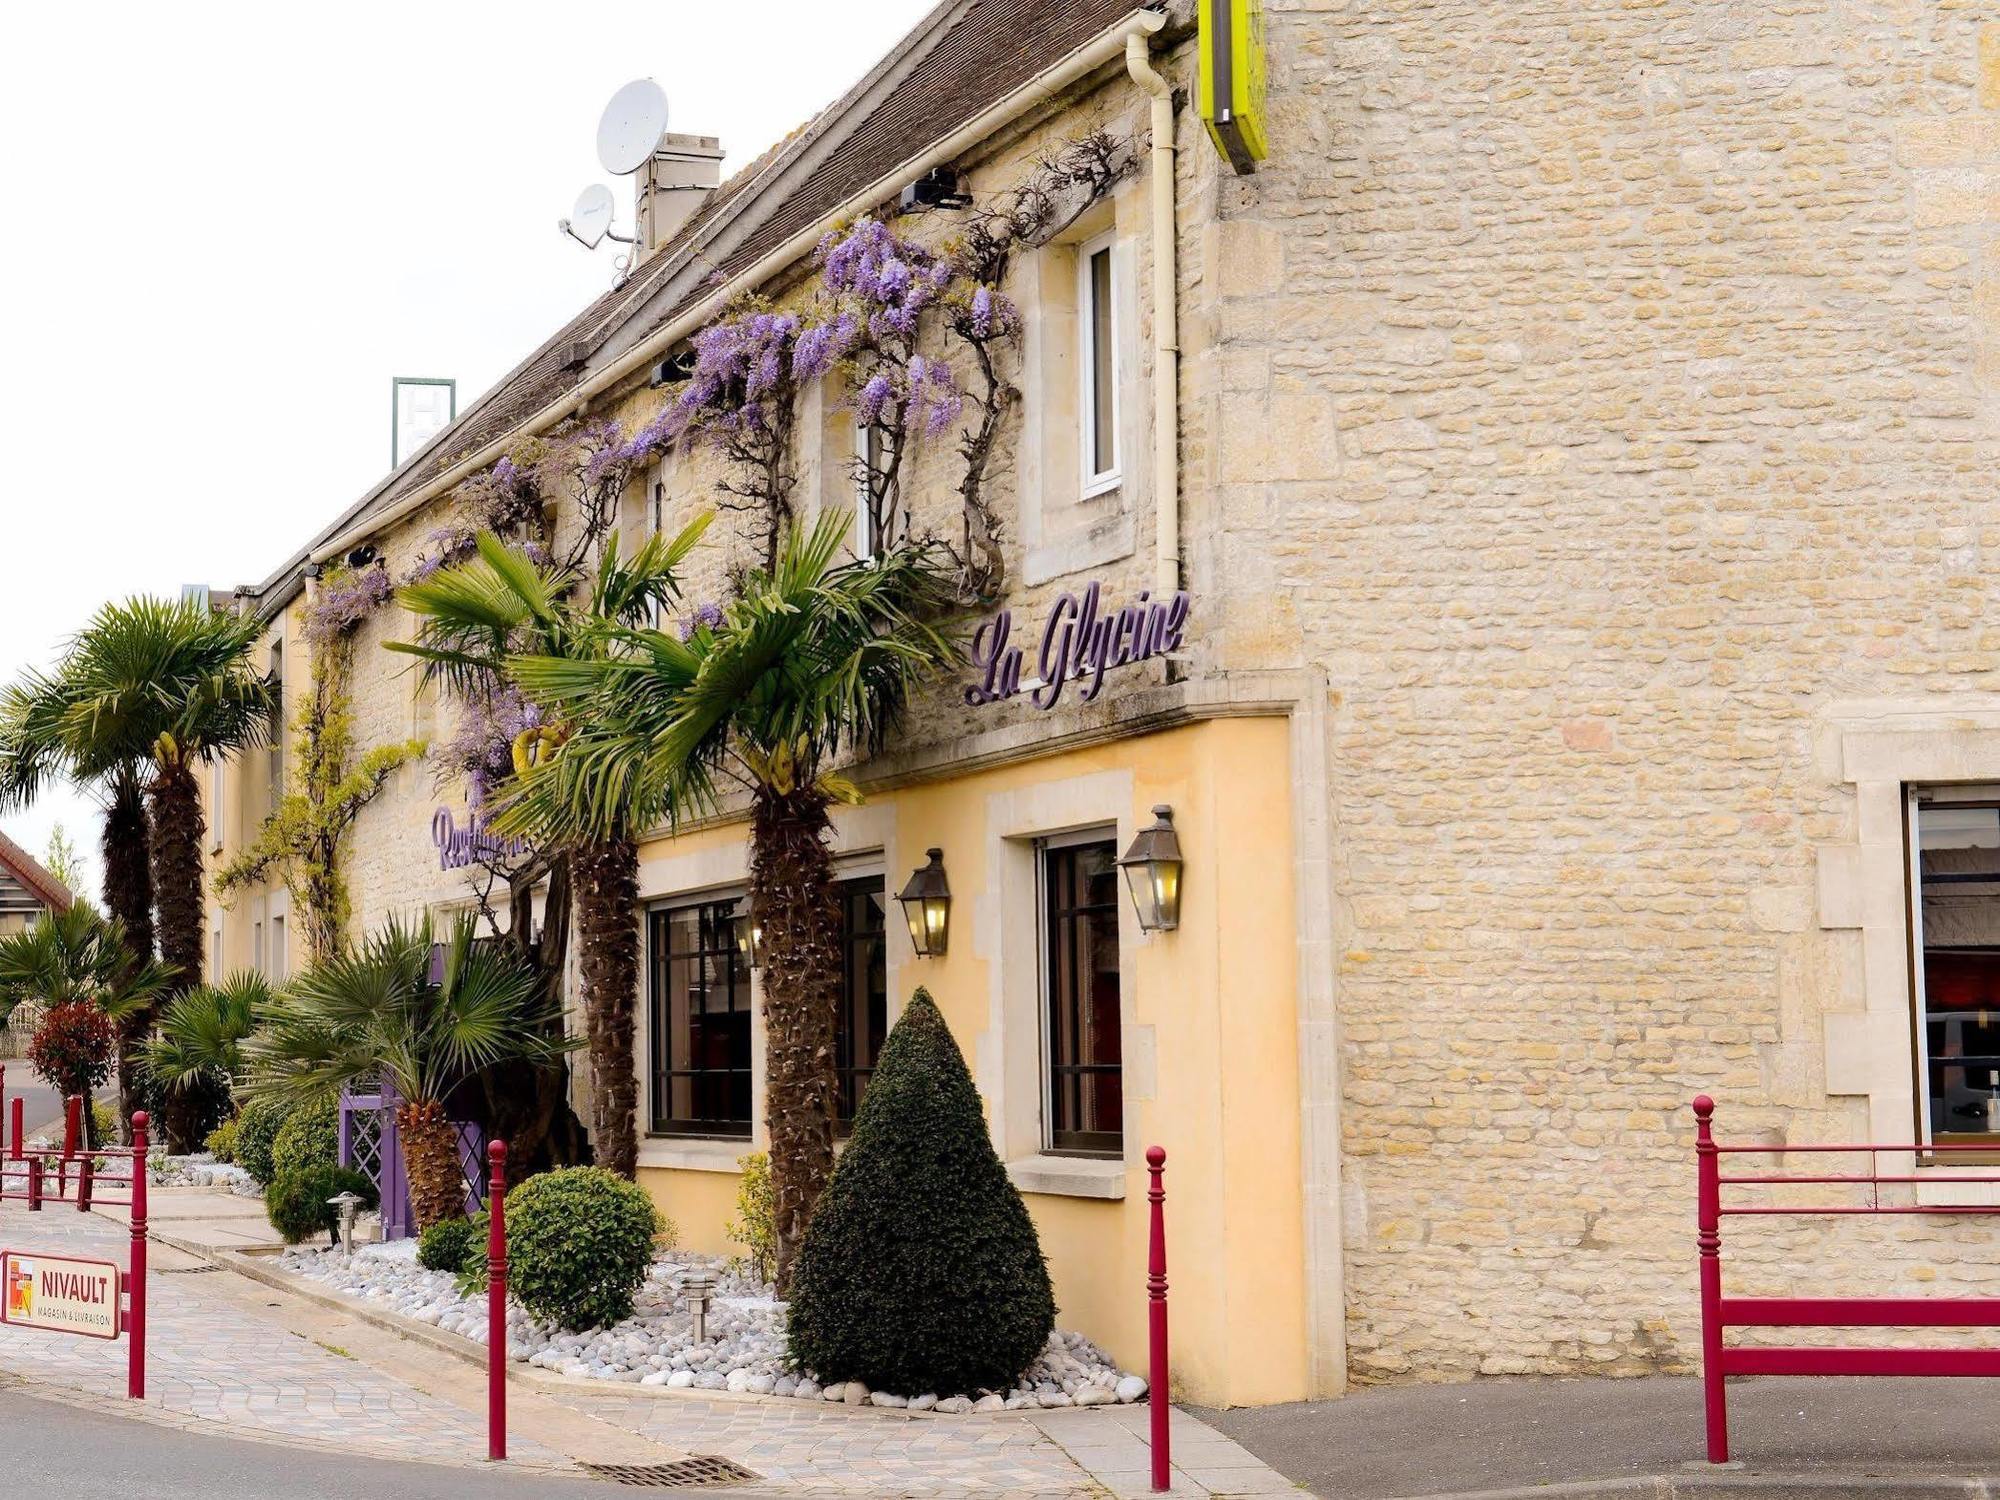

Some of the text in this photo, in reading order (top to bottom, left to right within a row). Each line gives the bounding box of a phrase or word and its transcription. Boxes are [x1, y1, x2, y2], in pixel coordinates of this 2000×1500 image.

[965, 580, 1190, 710] La Glycine
[42, 1270, 107, 1304] NIVAULT
[38, 1306, 67, 1320] MAGASIN
[74, 1311, 110, 1325] LIVRAISON
